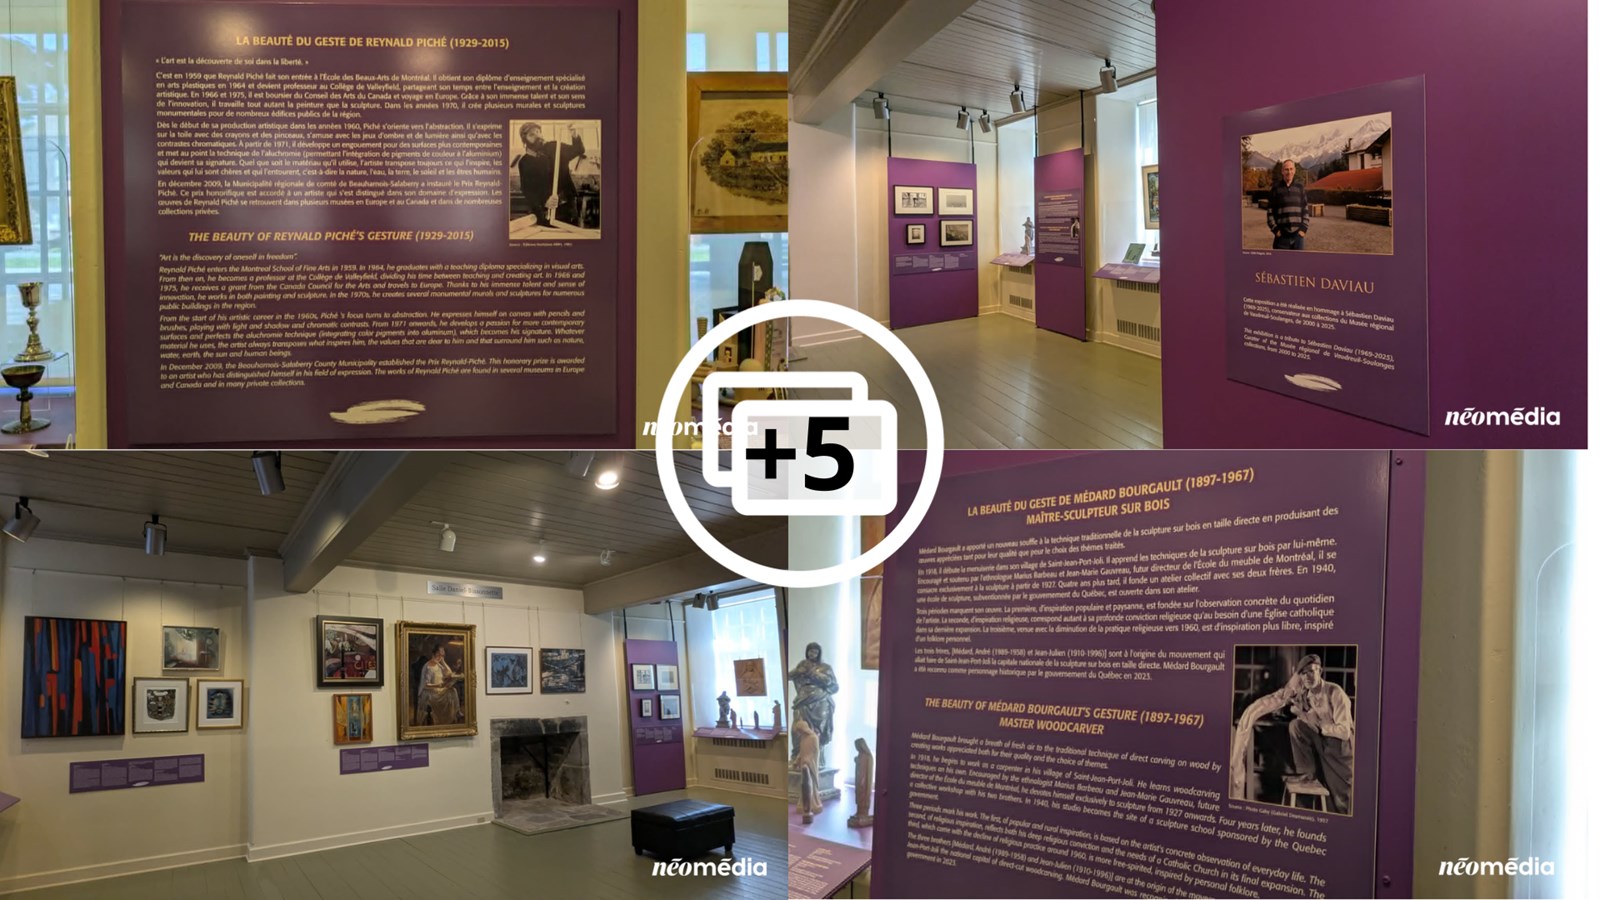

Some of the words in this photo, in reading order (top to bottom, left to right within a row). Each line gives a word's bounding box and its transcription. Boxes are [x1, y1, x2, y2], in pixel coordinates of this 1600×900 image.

[236, 36, 249, 45] LA
[252, 35, 292, 45] BEAUTÉ
[296, 37, 311, 45] DU
[314, 37, 346, 46] GESTE
[349, 37, 362, 46] DE
[365, 37, 413, 46] REYNALD
[416, 36, 446, 47] PICHÉ
[449, 37, 508, 49] (1929-2015)
[188, 232, 209, 241] THE
[212, 232, 254, 241] BEAUTY
[257, 231, 272, 240] OF
[273, 231, 321, 240] REYNALD
[324, 229, 364, 240] PICHÉ'S
[367, 231, 413, 240] GESTURE
[416, 230, 473, 242] (1929-2015)
[1255, 271, 1315, 287] SÉBASTIEN
[1321, 278, 1373, 293] DAVIAU
[967, 507, 978, 516] LA
[980, 500, 1011, 514] BEAUTÉ
[1014, 500, 1026, 510] DU
[1029, 496, 1056, 508] GESTE
[1058, 494, 1071, 505] DE
[1073, 488, 1116, 503] MÉDARD
[1119, 479, 1183, 497] BOURGAULT
[1186, 467, 1255, 491] (1897-1967)
[1026, 504, 1117, 524] MAÎTRE-SCULPTEUR
[1120, 501, 1141, 513] SUR
[1144, 498, 1169, 511] BOIS
[925, 698, 940, 707] THE
[941, 698, 974, 709] BEAUTY
[974, 700, 987, 710] OF
[987, 700, 1025, 712] MÉDARD
[1027, 704, 1090, 716] BOURGAULT'S
[1093, 708, 1138, 720] GESTURE
[1140, 710, 1205, 727] (1897-1967)
[999, 718, 1034, 728] MASTER
[1036, 720, 1104, 733] WOODCARVER
